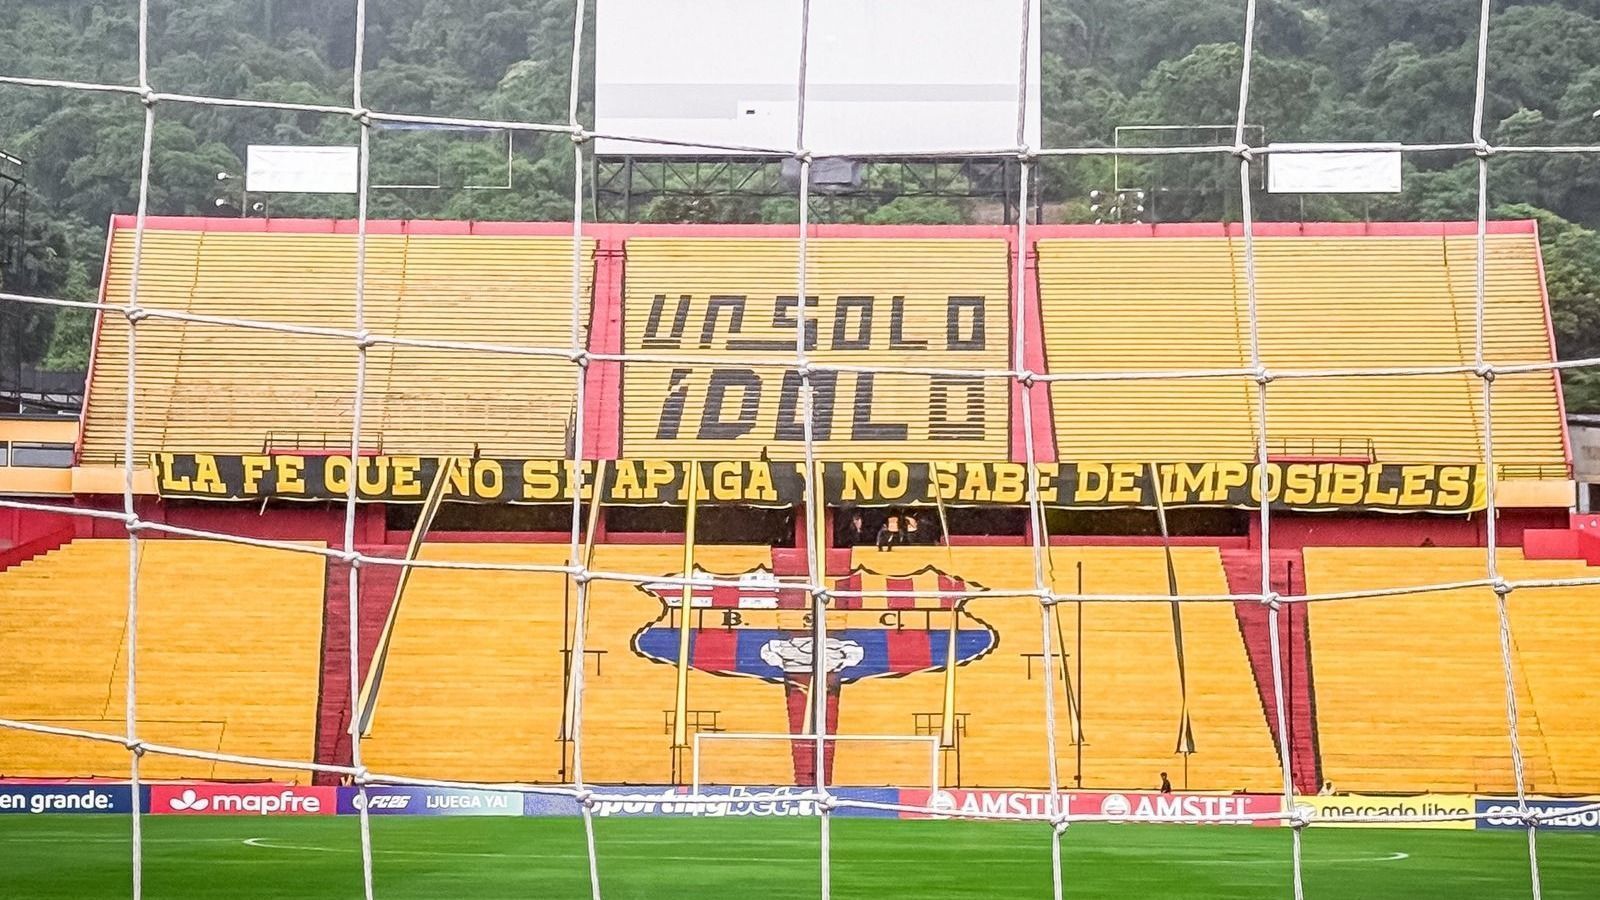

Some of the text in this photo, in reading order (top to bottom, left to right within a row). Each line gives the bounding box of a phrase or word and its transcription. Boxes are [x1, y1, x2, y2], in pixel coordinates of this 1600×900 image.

[726, 296, 986, 351] SOLO
[160, 453, 227, 494] LA
[242, 455, 305, 494] FE
[323, 454, 422, 496] QUE
[437, 456, 504, 498] NO
[522, 460, 594, 499] SE
[611, 459, 778, 501] APAGA
[841, 461, 910, 501] NO
[927, 461, 1060, 503] SABE
[1074, 463, 1144, 503] DE
[1158, 461, 1470, 507] IMPOSIBLES
[0, 793, 26, 809] en
[213, 790, 320, 815] mapfre
[1135, 796, 1253, 825] AMSTEL
[1321, 803, 1469, 817] mercado libre
